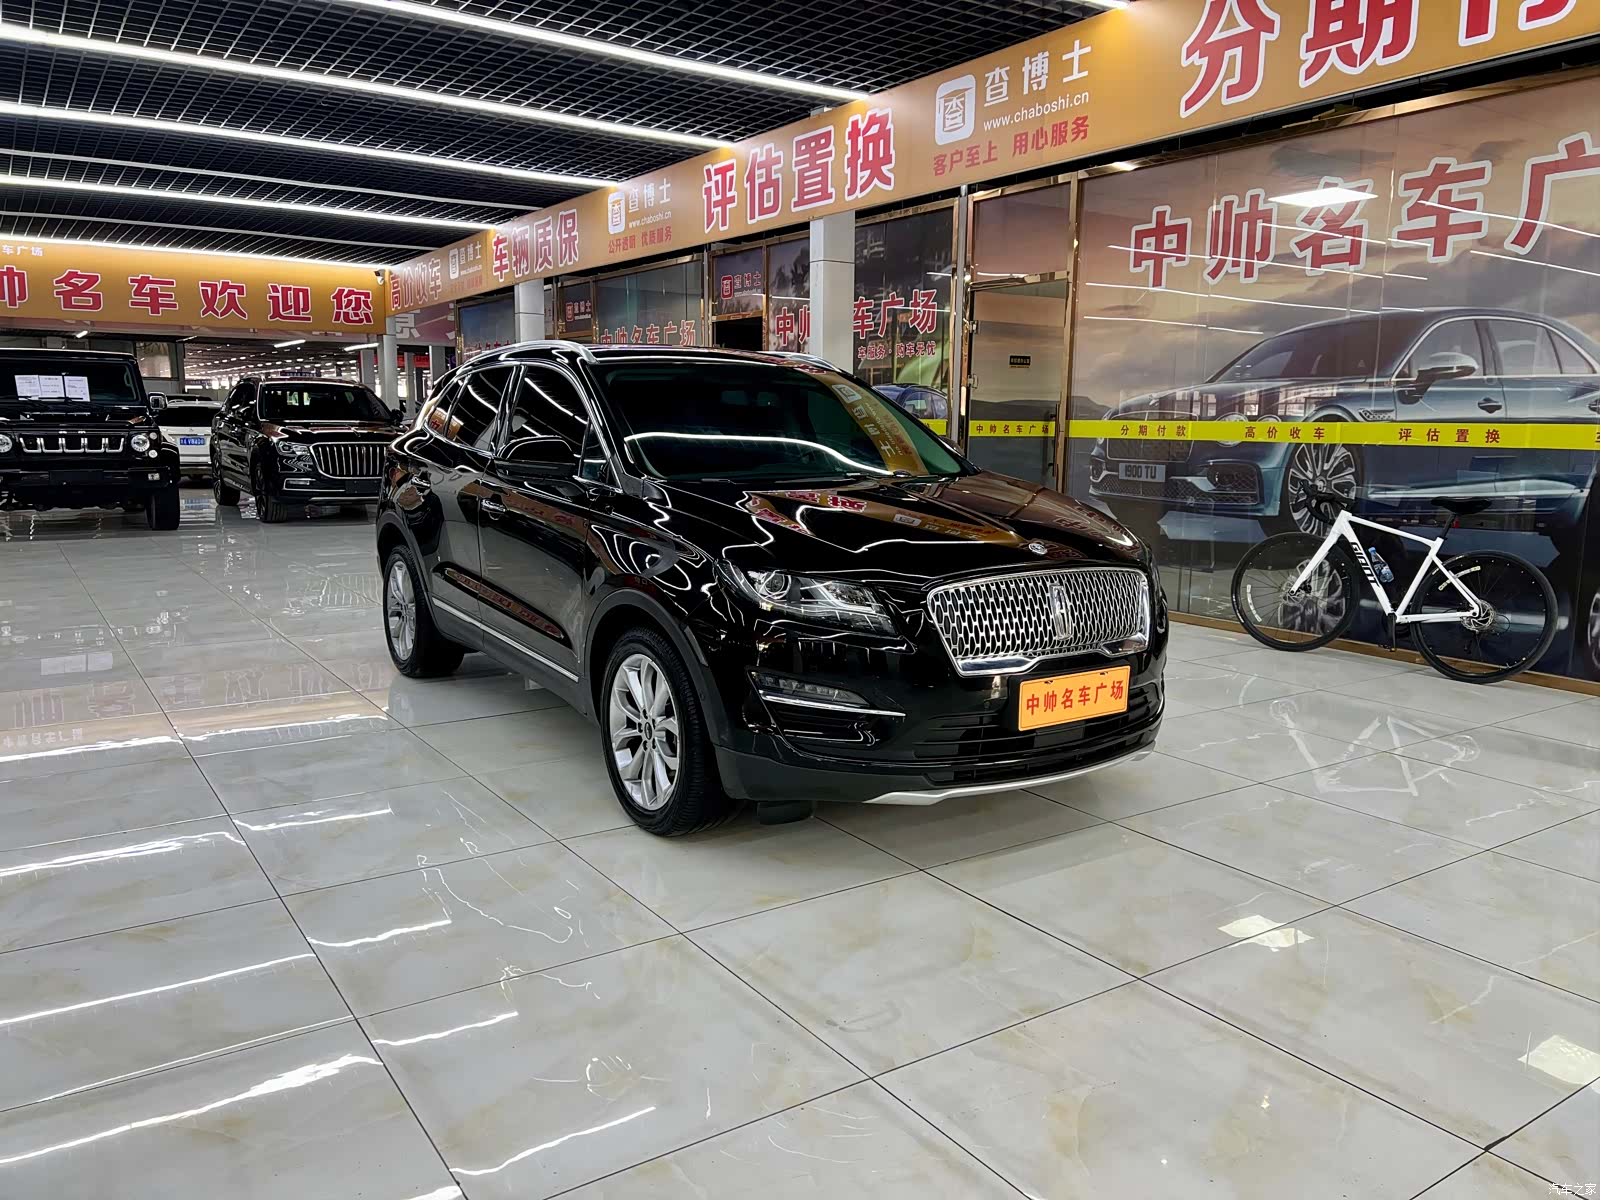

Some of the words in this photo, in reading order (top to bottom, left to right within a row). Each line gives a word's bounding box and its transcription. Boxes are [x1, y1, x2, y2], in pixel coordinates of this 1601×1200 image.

[984, 39, 1092, 107] 查博士
[983, 91, 1090, 132] www.chaboshi.cn
[933, 140, 999, 177] 客户至上
[1012, 115, 1090, 158] 用心服务
[702, 106, 898, 234] 评估置换
[628, 177, 671, 213] 查博士
[492, 209, 579, 282] 车辆质保
[390, 257, 442, 311] 高价收车
[976, 424, 1050, 435] 中帅名车广场
[1120, 424, 1187, 437] 分期付款
[1244, 425, 1326, 440] 高价收车
[1398, 427, 1501, 444] 评估置换
[1026, 680, 1124, 716] 中帅名车广场
